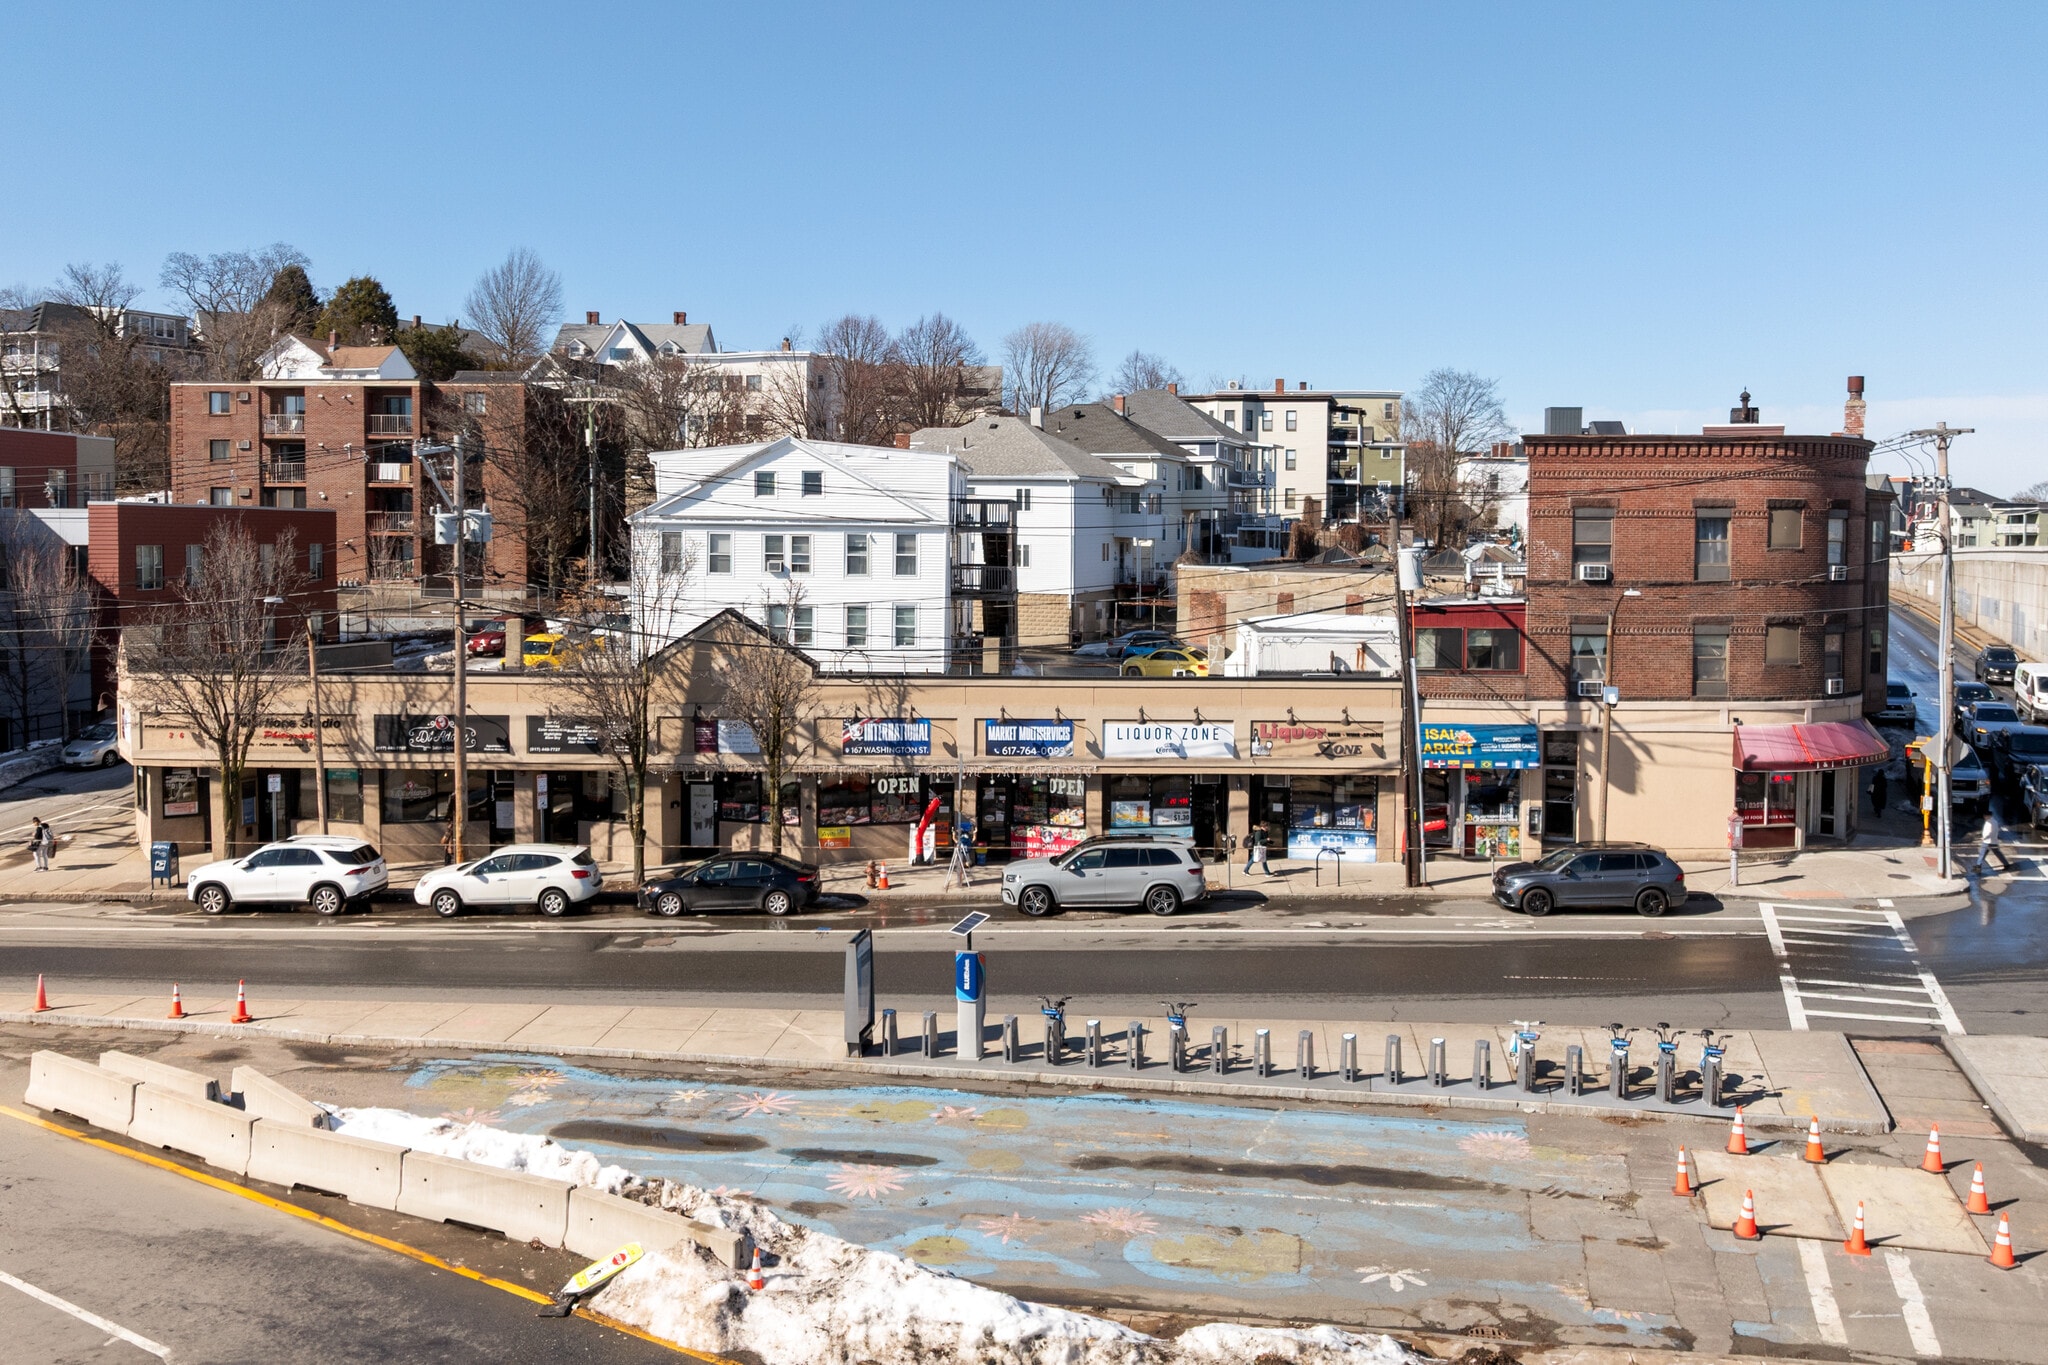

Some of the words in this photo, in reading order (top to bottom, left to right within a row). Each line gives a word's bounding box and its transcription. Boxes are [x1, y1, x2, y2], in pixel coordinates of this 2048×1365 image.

[300, 717, 341, 729] Stdio
[864, 723, 929, 741] INTERNATIONAL
[988, 726, 1017, 741] MARKET
[1019, 726, 1071, 741] MULTISERVICES
[1117, 727, 1172, 740] LIQUOR
[1182, 728, 1219, 740] ZONE
[1260, 723, 1326, 743] Liquor
[1316, 742, 1363, 757] ZONE
[1423, 743, 1474, 755] ARKET
[877, 777, 920, 794] OPEN
[1049, 778, 1085, 796] OPEN
[1011, 841, 1059, 851] INTERNATIONAL
